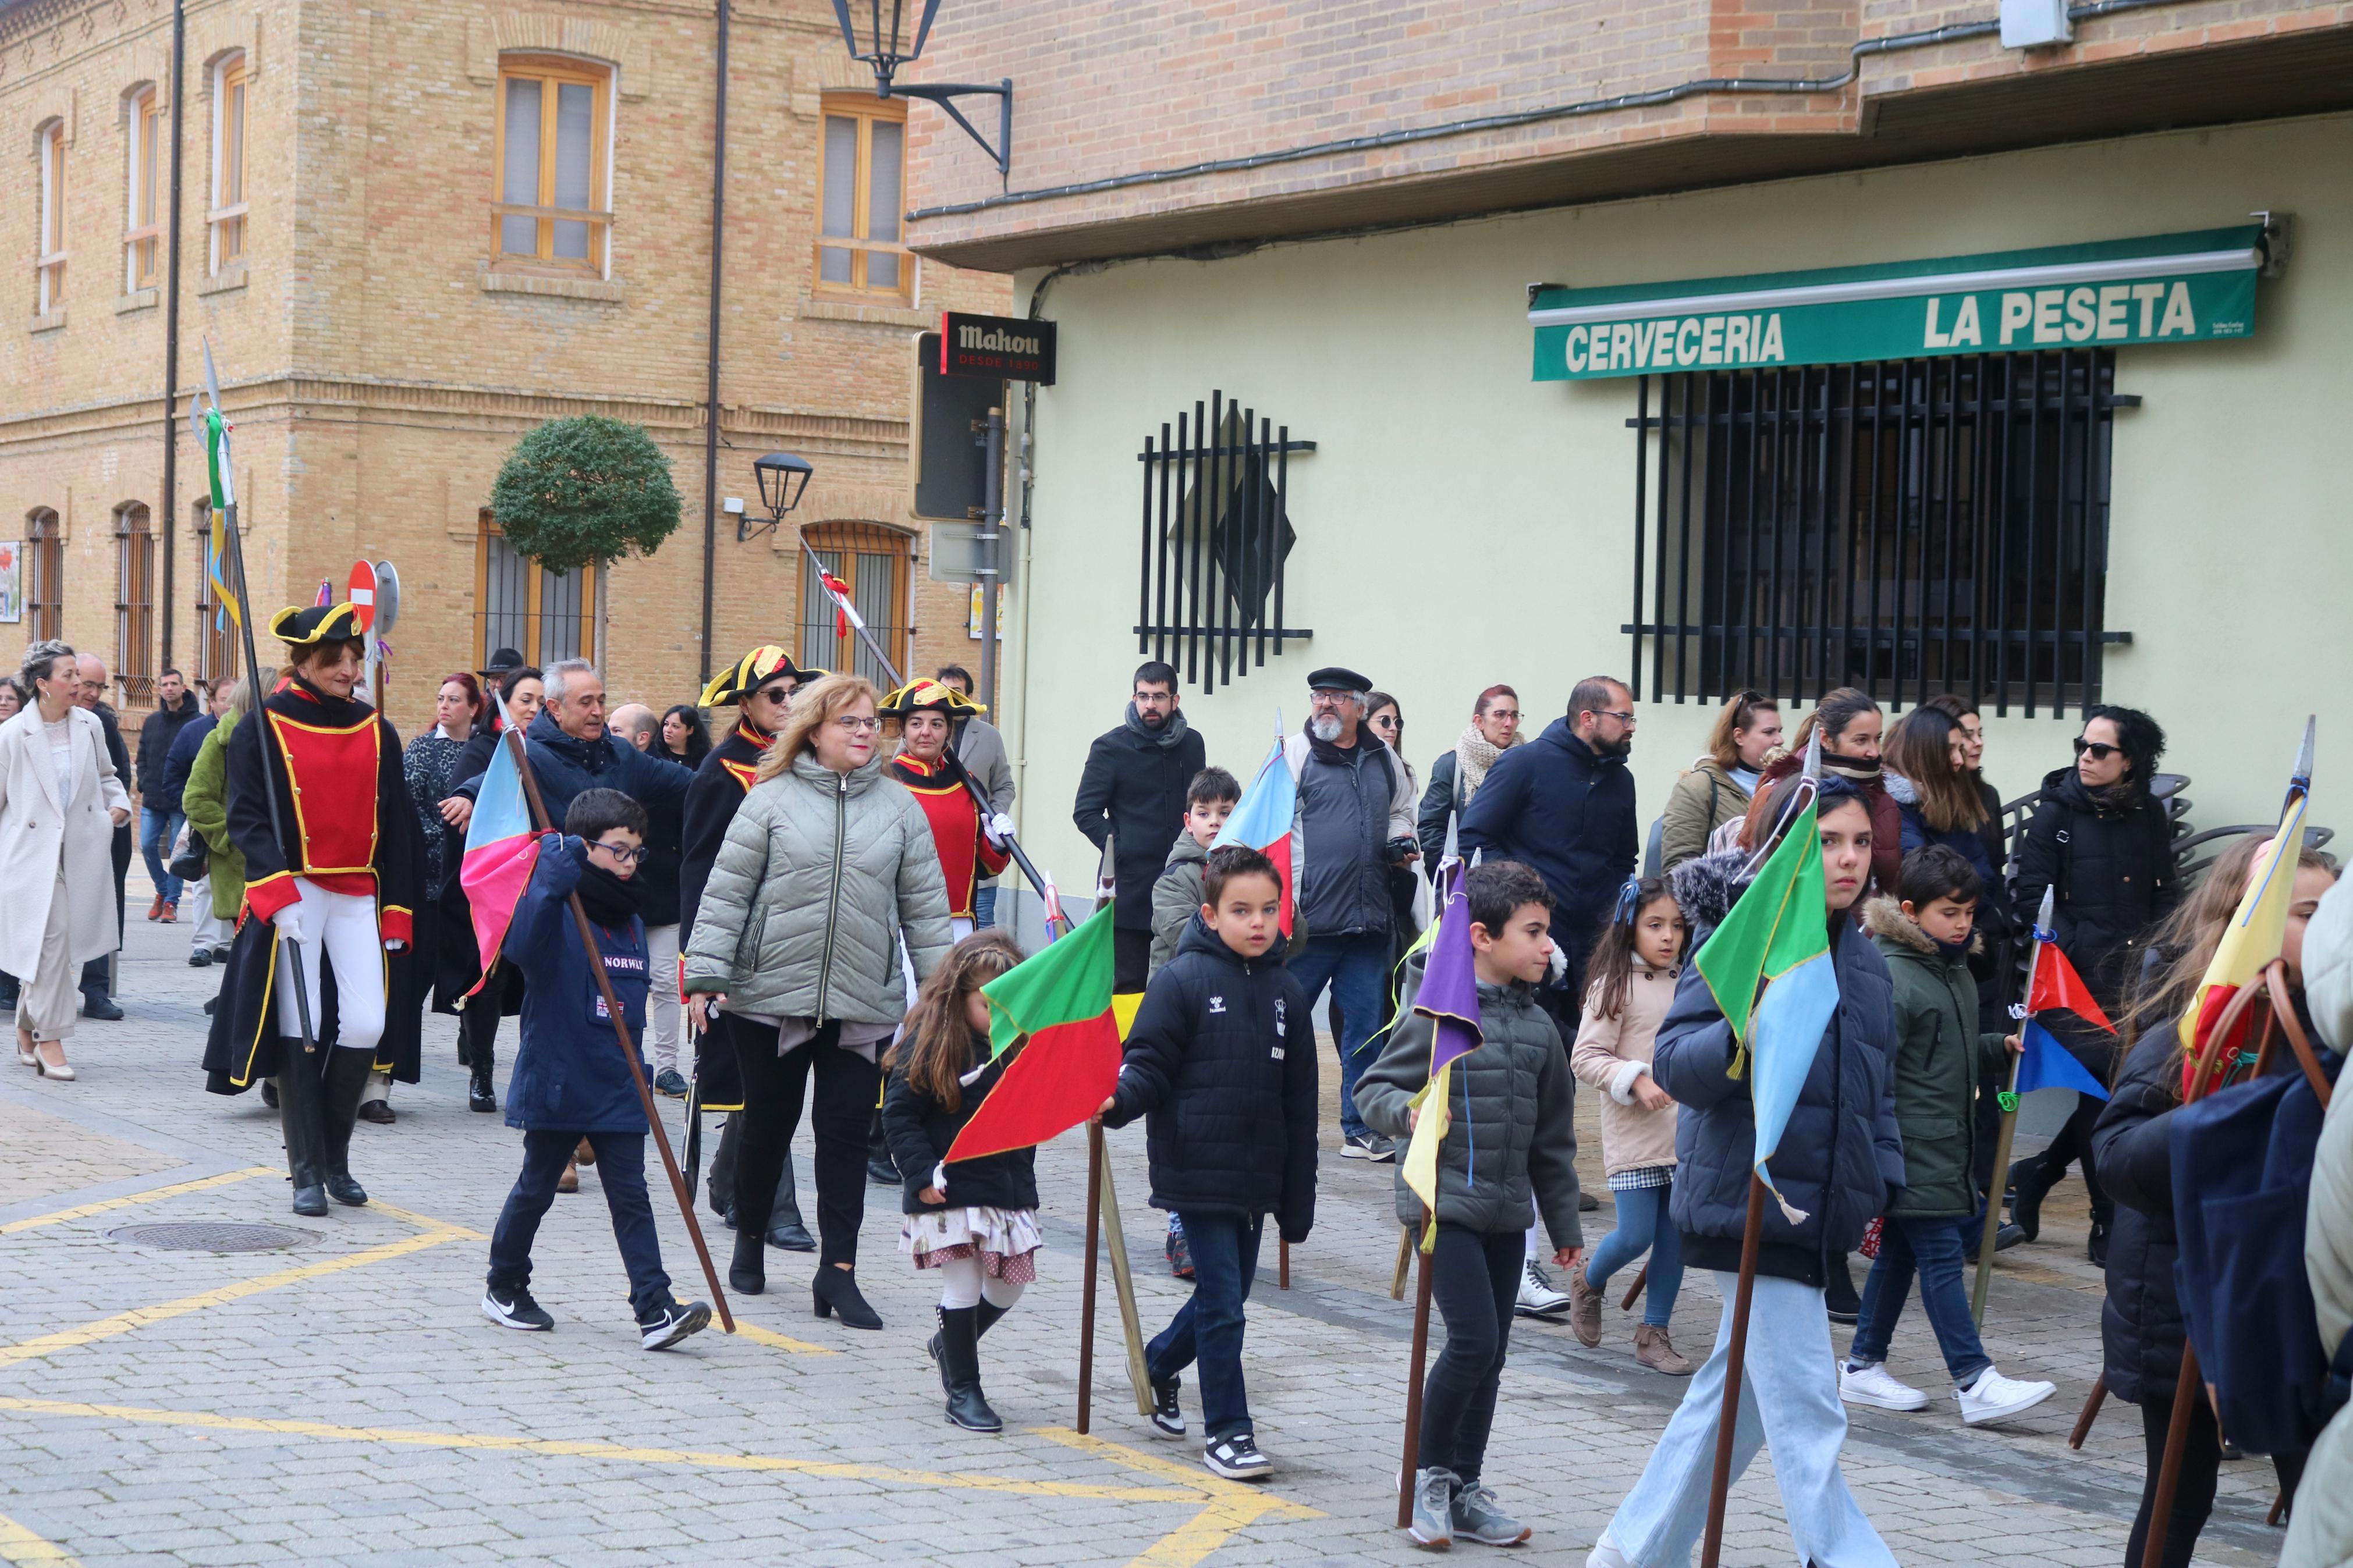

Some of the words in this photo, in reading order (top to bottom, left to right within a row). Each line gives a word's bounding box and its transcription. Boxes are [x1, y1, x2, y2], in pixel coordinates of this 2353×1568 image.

[1923, 296, 1981, 348] LA
[1999, 282, 2196, 344] PESETA
[959, 325, 1039, 355] Mahou
[1566, 313, 1784, 372] CERVECERIA
[959, 354, 1002, 367] DESDE
[1009, 359, 1038, 370] 1890
[604, 957, 643, 970] NORWAY
